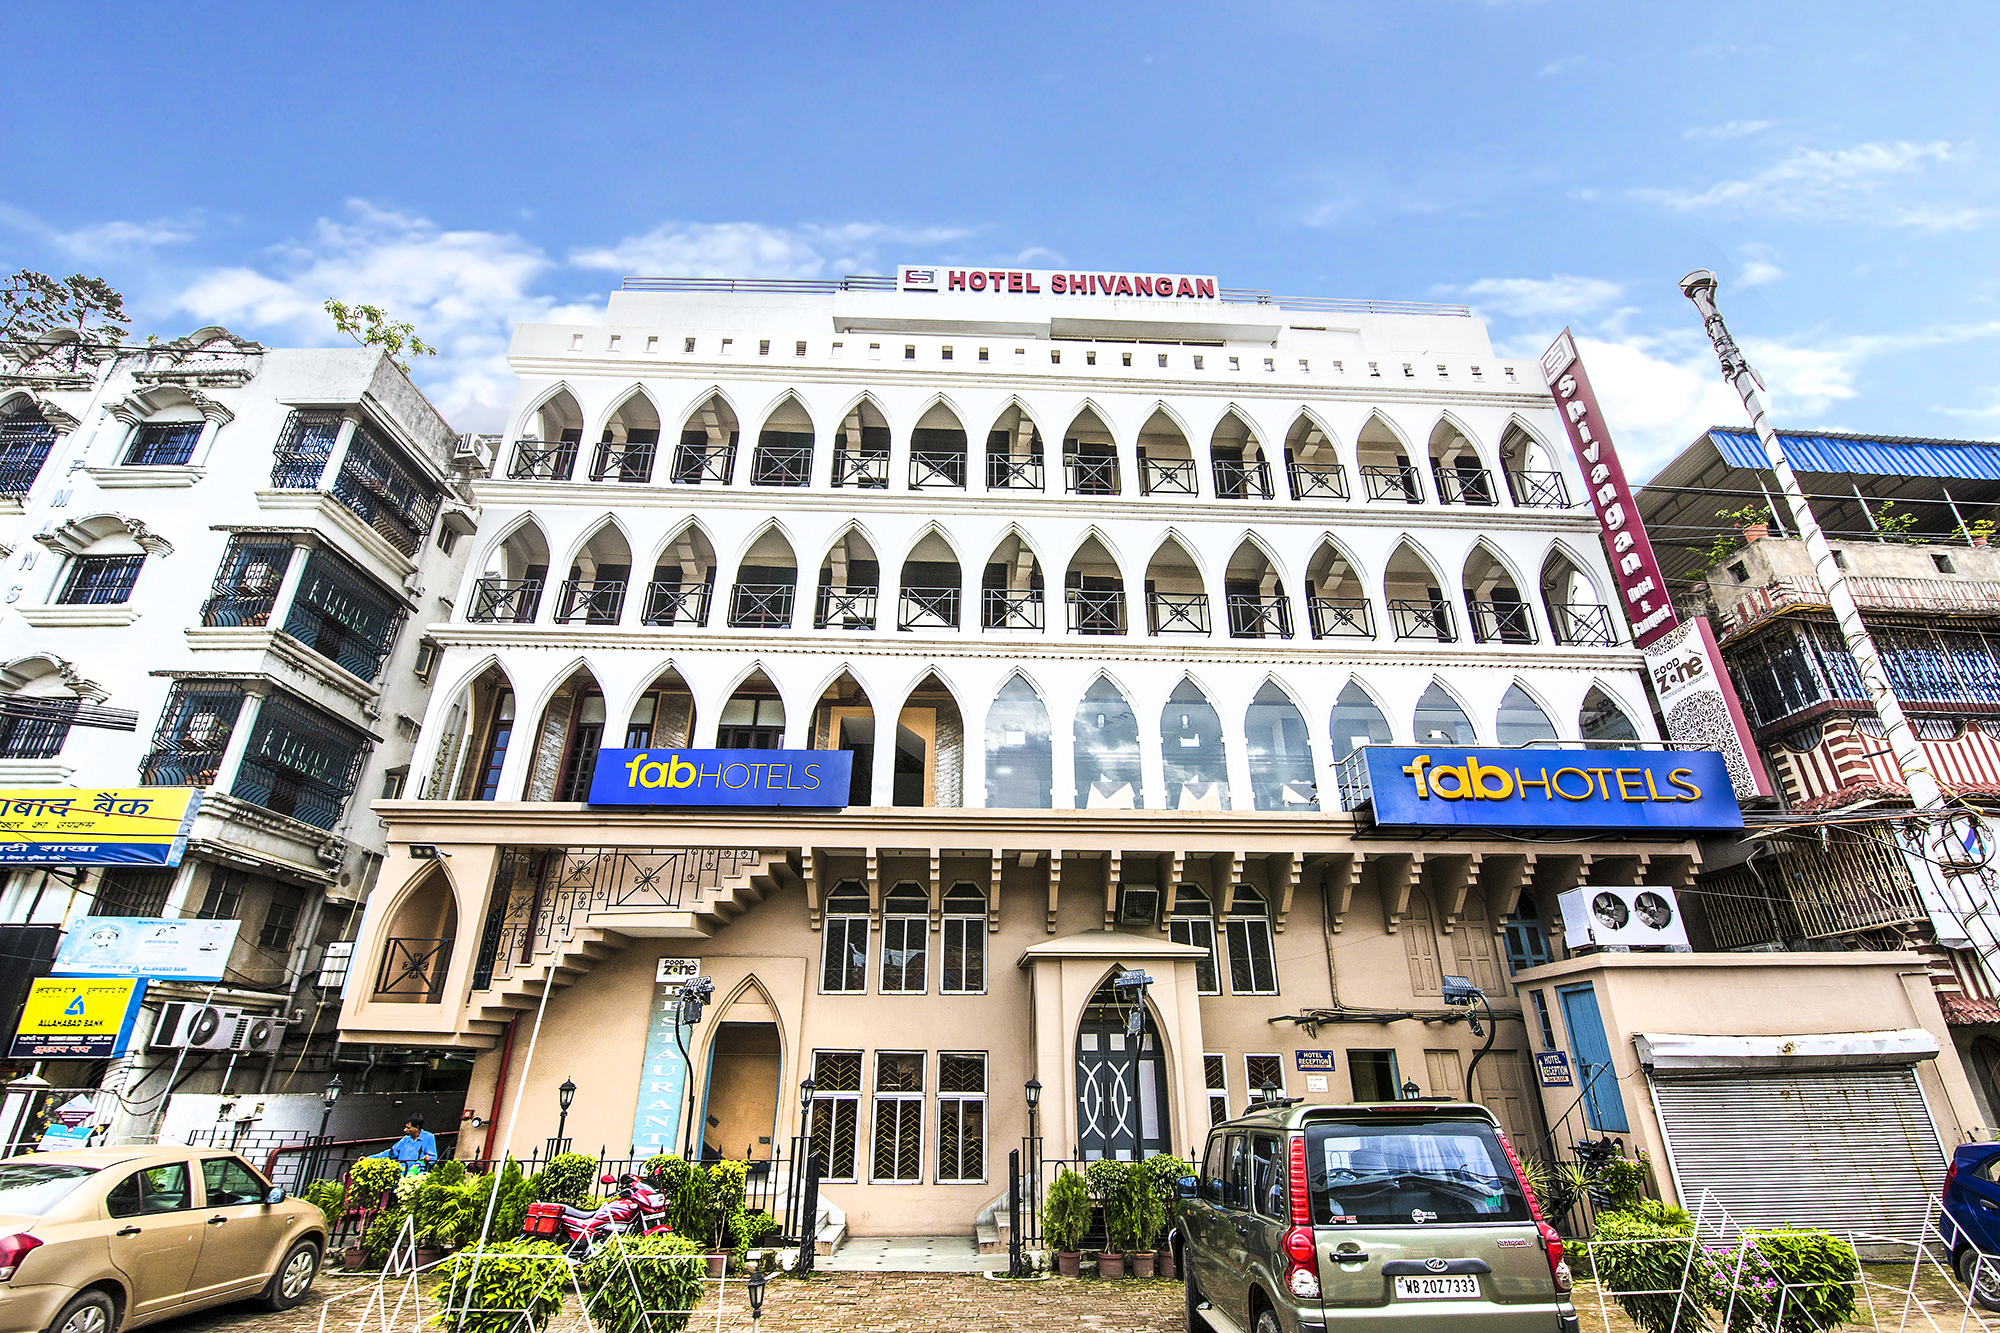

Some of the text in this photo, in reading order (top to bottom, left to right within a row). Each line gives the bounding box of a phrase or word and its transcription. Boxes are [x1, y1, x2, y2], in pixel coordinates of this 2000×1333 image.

[949, 270, 1216, 299] HOTEL SHIVANGAN
[1640, 600, 1652, 614] &
[1653, 657, 1680, 678] FOOD
[625, 753, 821, 790] fabHOTELS
[1402, 754, 1702, 802] fabHOTELS
[93, 792, 154, 818] बैंक
[37, 1019, 82, 1027] ALLAHABAD
[1543, 1055, 1562, 1065] HOTEL
[1543, 1065, 1569, 1076] RECEPTION
